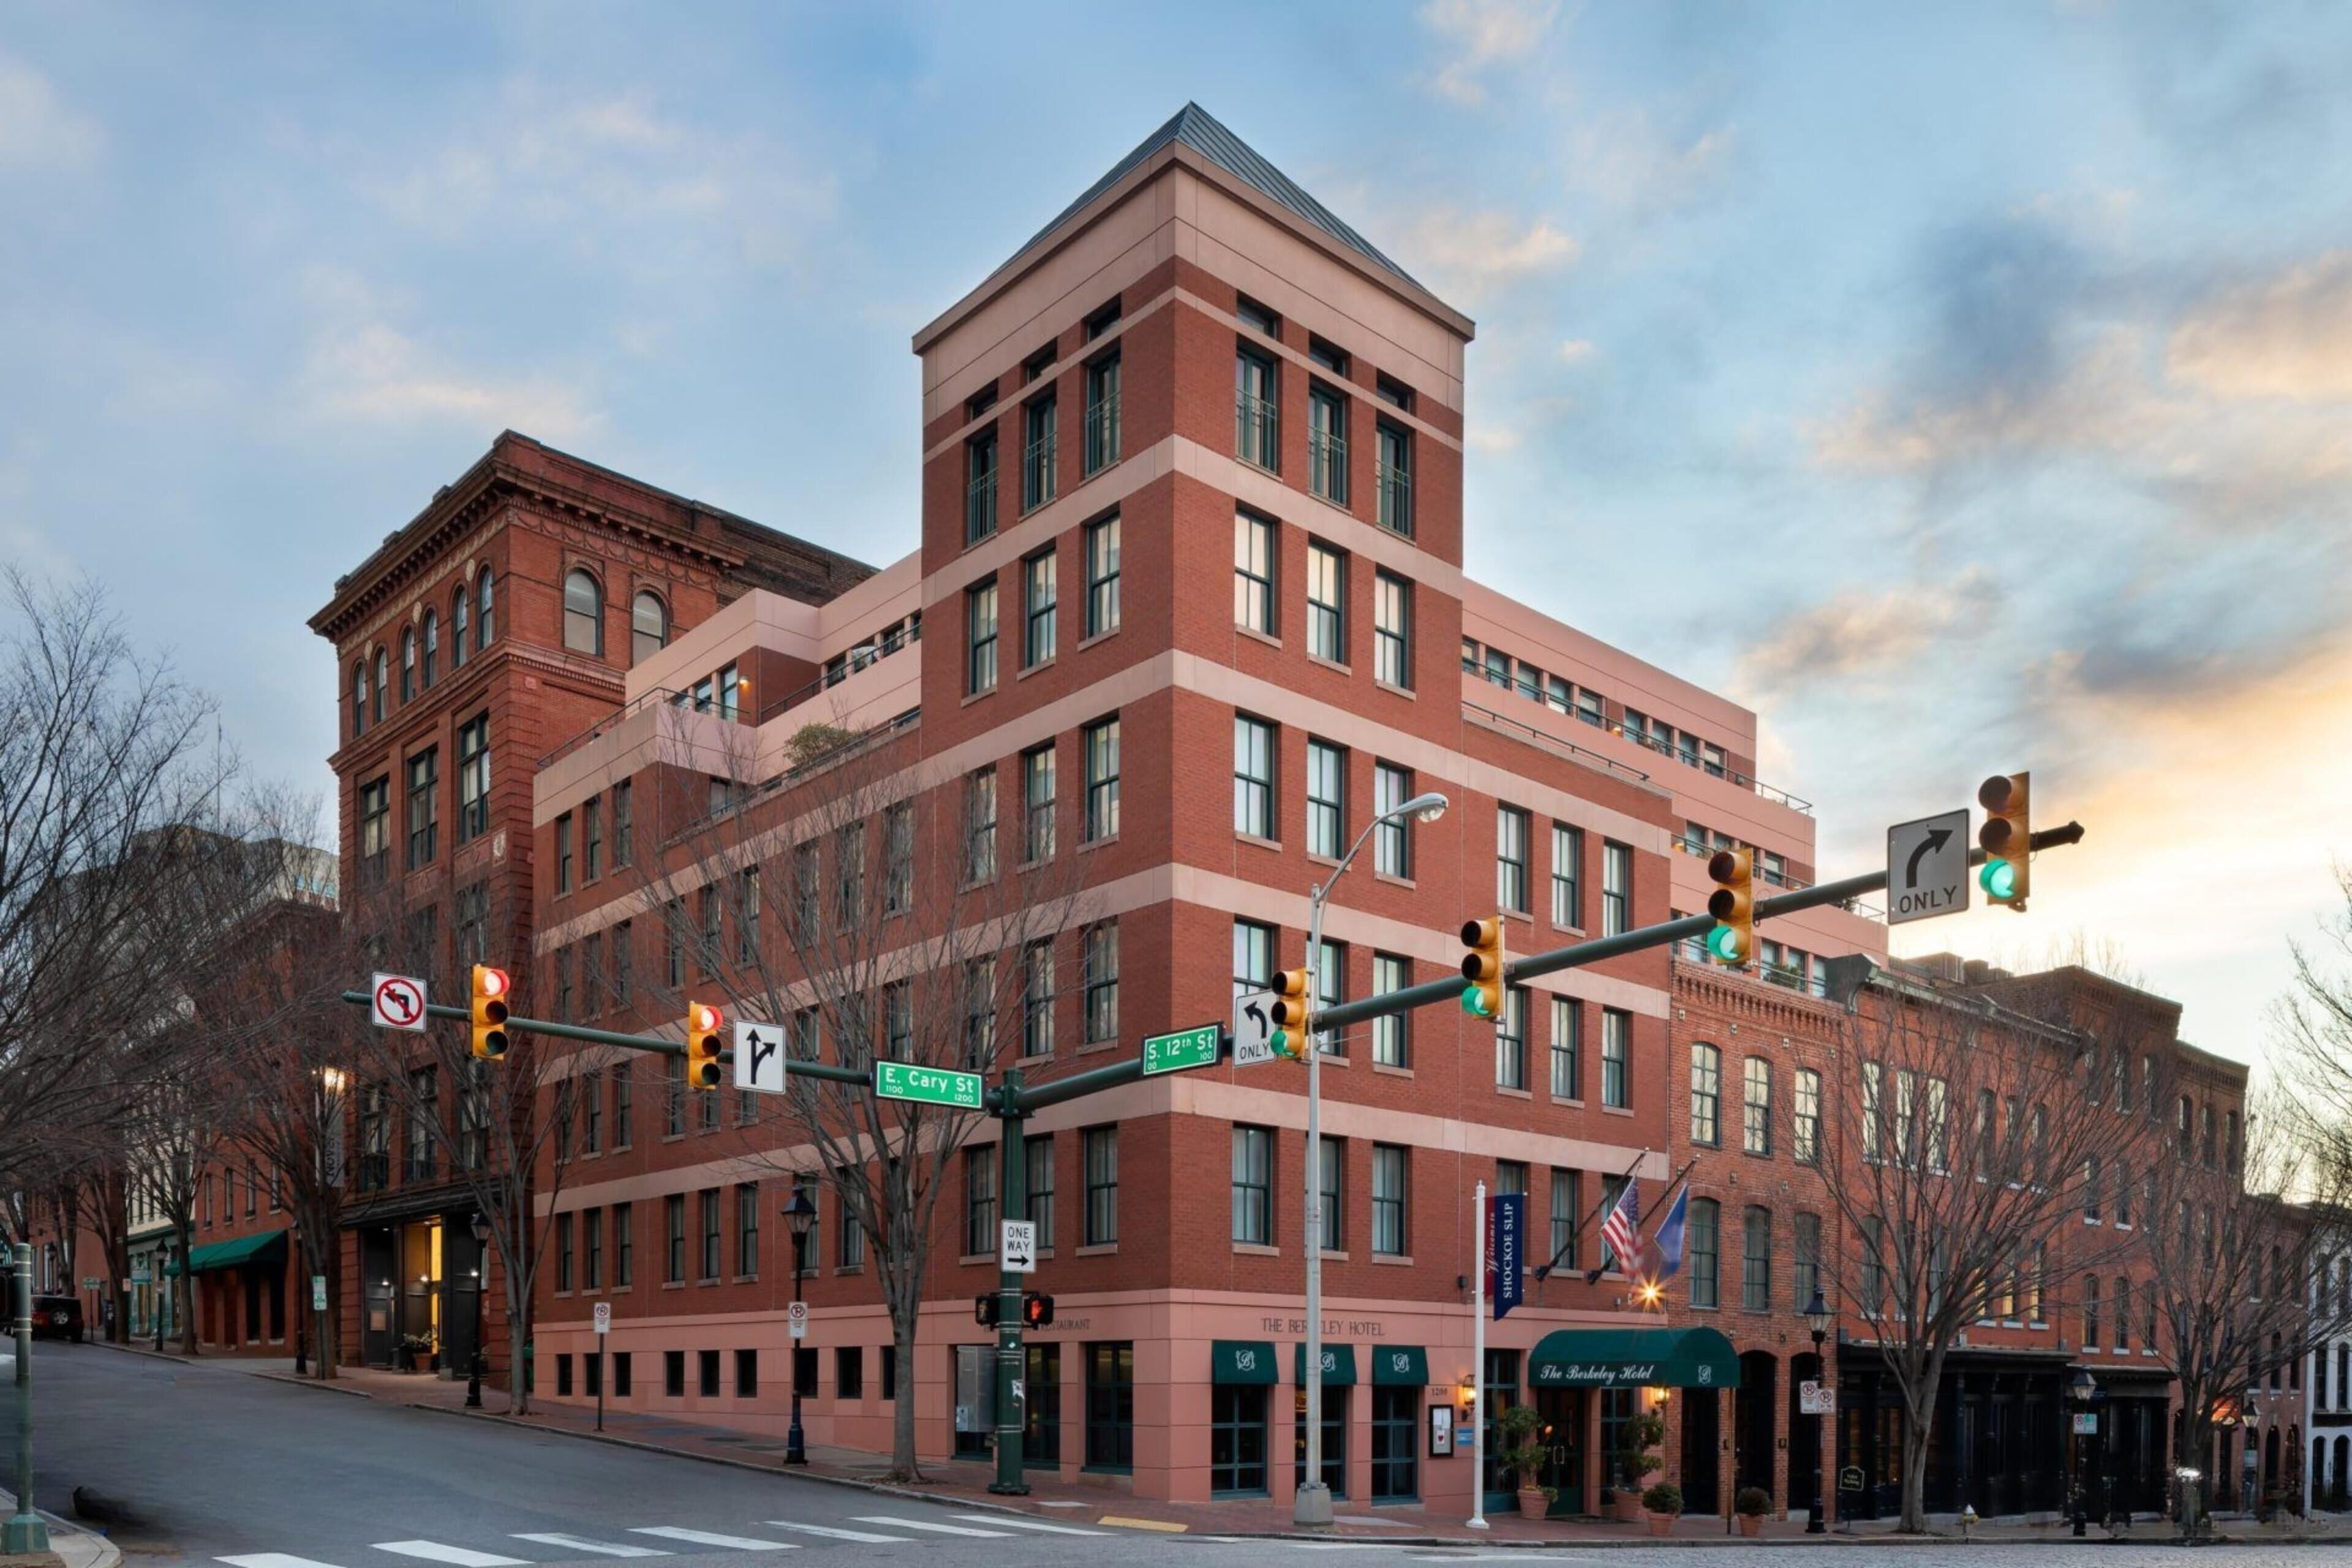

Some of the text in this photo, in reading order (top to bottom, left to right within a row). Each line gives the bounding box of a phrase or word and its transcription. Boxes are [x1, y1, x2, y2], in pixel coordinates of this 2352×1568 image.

[1899, 885, 1958, 913] ONLY
[1148, 1044, 1161, 1060] S.
[1197, 1033, 1213, 1050] St
[1200, 1051, 1213, 1060] 100
[1239, 1042, 1270, 1060] ONLY
[885, 1068, 973, 1093] E. Cary St
[886, 1085, 903, 1094] 1100
[955, 1093, 973, 1102] 1200
[1008, 1226, 1030, 1238] ONE
[1007, 1240, 1030, 1252] WAY
[1503, 1203, 1513, 1298] SHOCKOE SLIP
[1261, 1318, 1283, 1332] THE
[1349, 1321, 1385, 1336] HOTEL
[1540, 1364, 1654, 1385] The Berkeley Hotel
